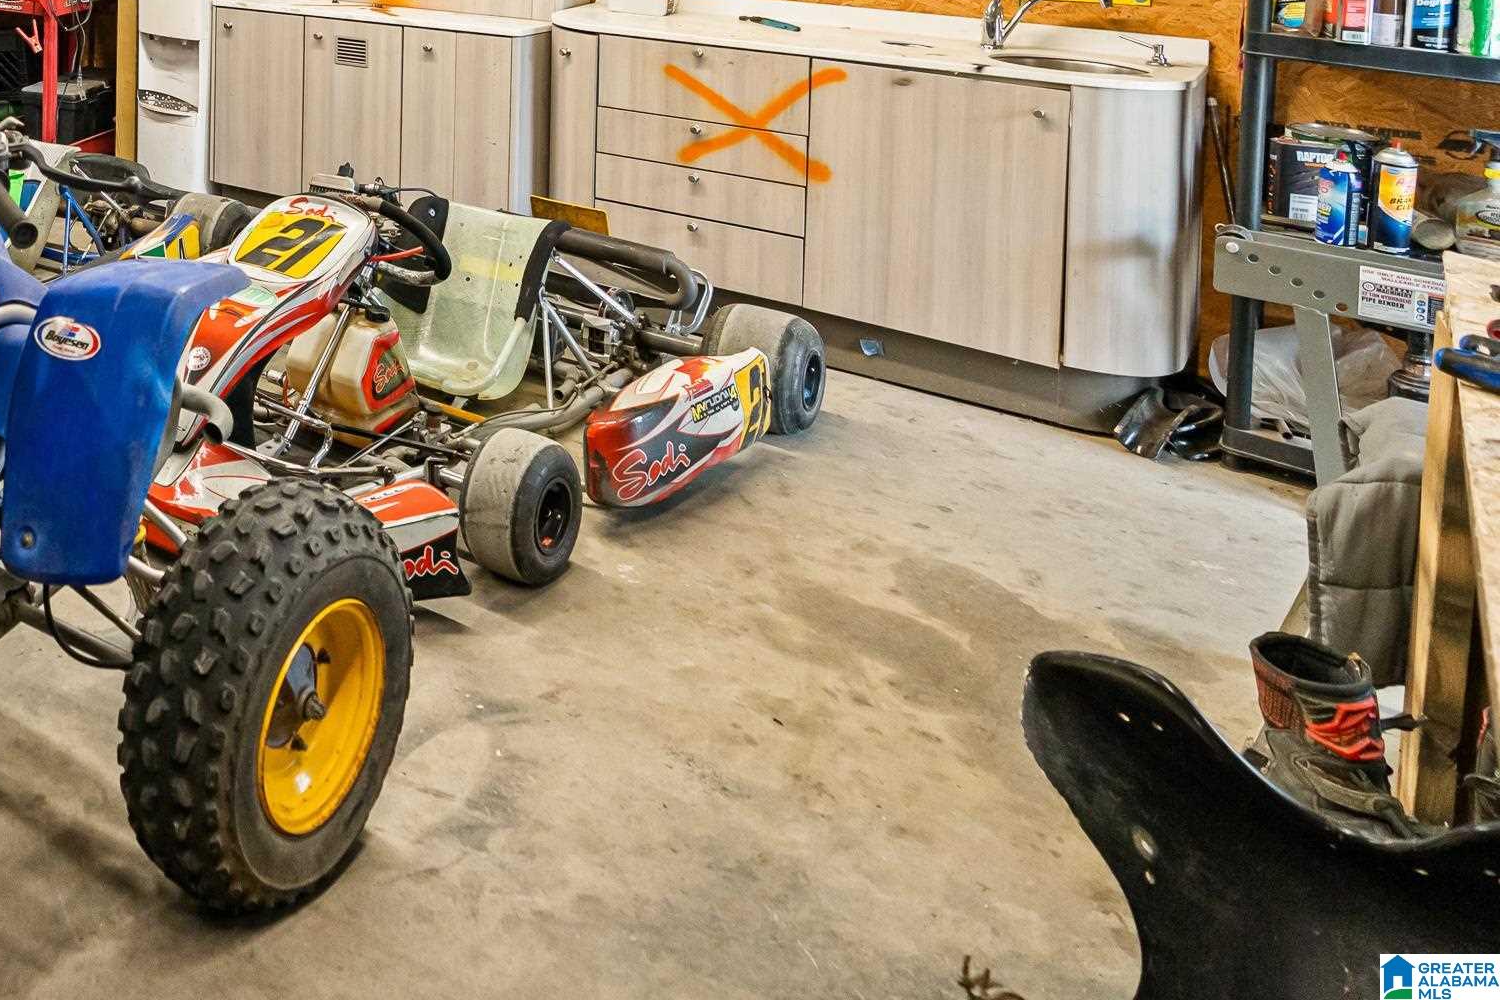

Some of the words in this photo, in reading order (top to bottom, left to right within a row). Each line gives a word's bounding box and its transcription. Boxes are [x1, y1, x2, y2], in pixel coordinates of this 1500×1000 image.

[285, 196, 336, 223] Sodi
[236, 217, 348, 273] 21
[1361, 296, 1376, 304] PIPE
[1378, 299, 1405, 309] BENDER
[44, 330, 90, 350] Boyesen
[373, 360, 404, 393] Sodi
[612, 440, 690, 501] Sodi
[403, 545, 459, 580] odi
